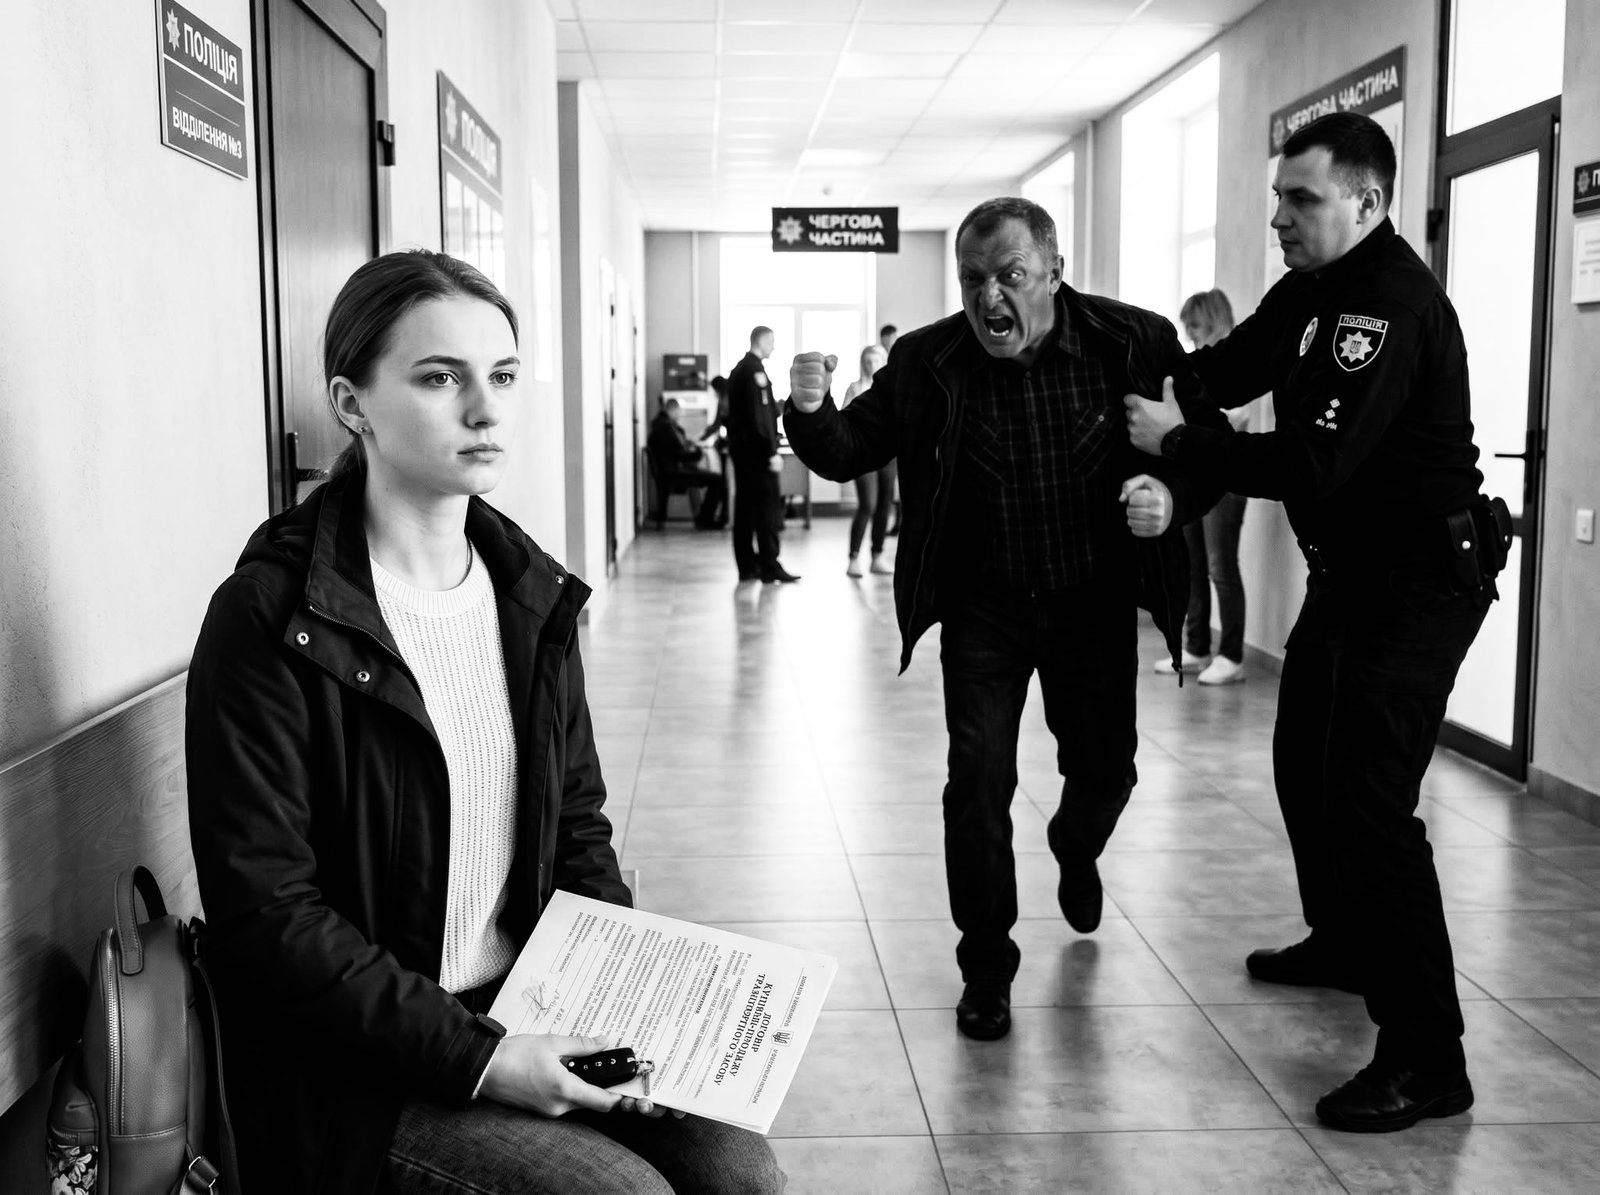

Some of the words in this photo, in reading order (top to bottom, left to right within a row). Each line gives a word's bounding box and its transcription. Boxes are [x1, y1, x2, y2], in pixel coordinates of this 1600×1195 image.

[184, 23, 238, 84] ПОЛІЦІЯ
[1339, 65, 1398, 111] ЧАСТИНА
[172, 106, 227, 151] ВІДДІЛЕННЯ
[228, 135, 242, 159] №3
[808, 214, 884, 230] ЧЕРГОВА
[808, 231, 885, 246] ЧАСТИНА
[1343, 317, 1383, 330] ПОЛІЦІЯ
[751, 1012, 772, 1053] ДОГОВІР
